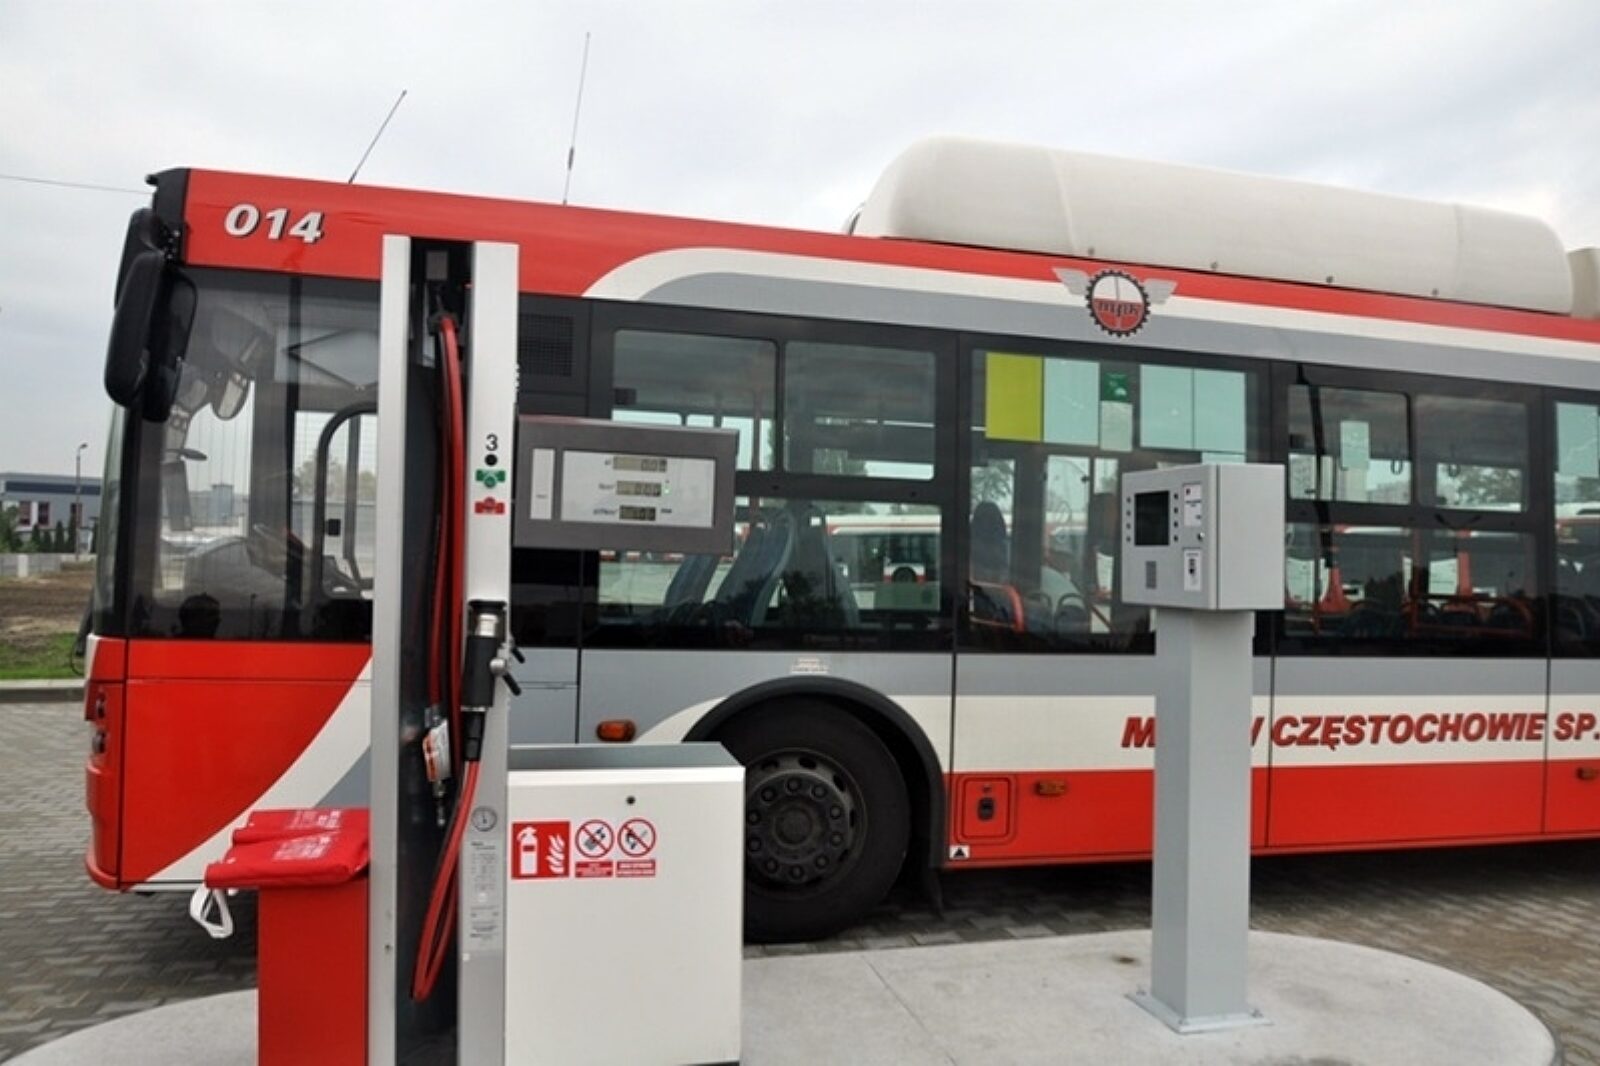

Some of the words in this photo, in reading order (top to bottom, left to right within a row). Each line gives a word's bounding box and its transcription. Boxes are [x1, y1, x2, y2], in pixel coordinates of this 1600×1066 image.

[224, 203, 324, 244] 014
[486, 433, 499, 452] 3
[1272, 713, 1547, 751] CZĘSTOCHOWIE
[1553, 712, 1600, 741] SP.
